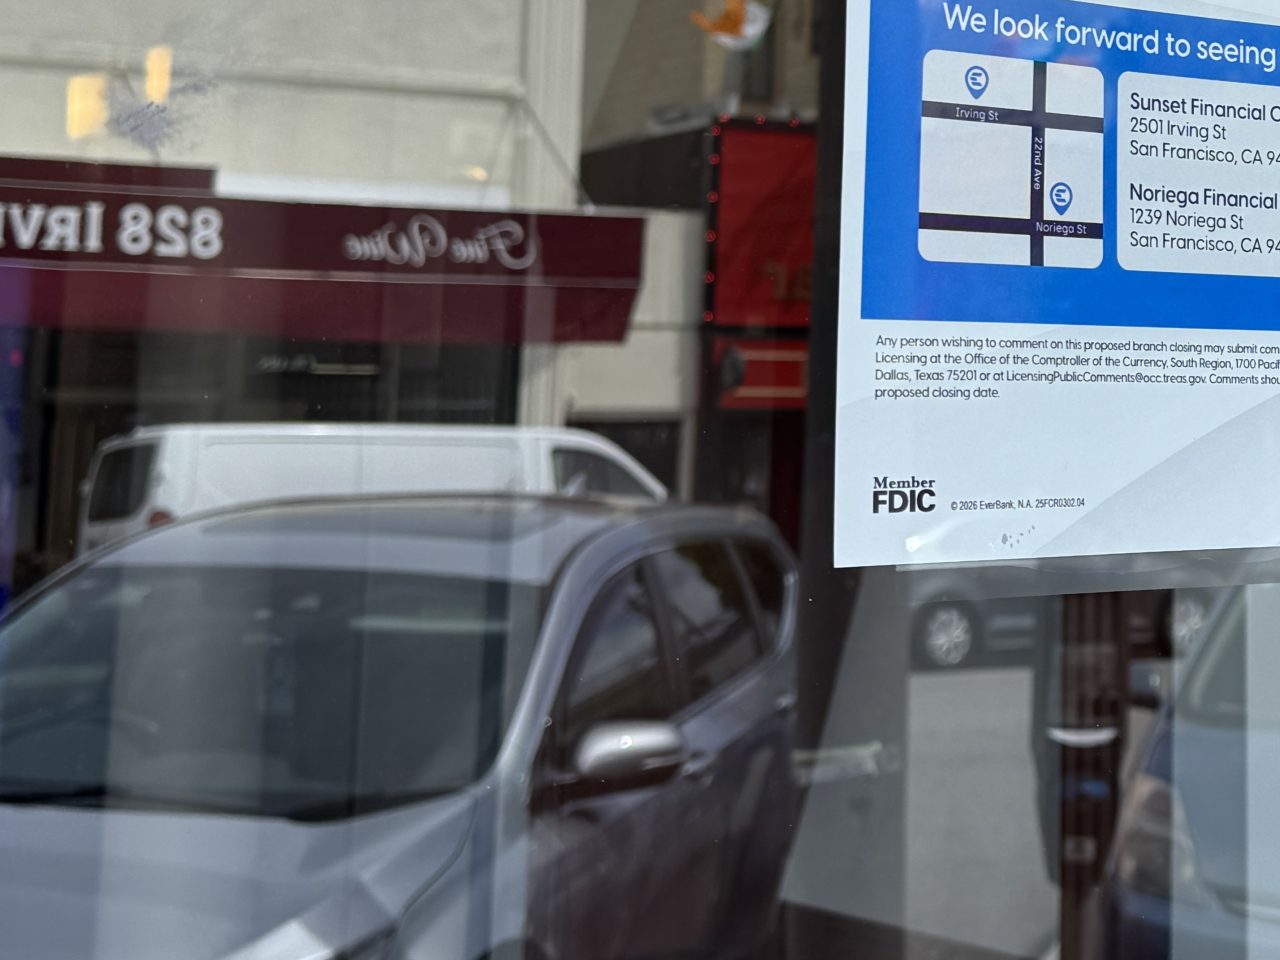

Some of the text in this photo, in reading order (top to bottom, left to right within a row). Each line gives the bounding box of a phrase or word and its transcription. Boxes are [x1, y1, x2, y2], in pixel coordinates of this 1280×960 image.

[944, 2, 986, 32] We
[994, 9, 1048, 40] look
[1056, 17, 1158, 54] forward
[1166, 33, 1190, 57] to
[1197, 40, 1275, 72] seeing
[955, 108, 999, 122] Irving St
[1131, 93, 1186, 114] Sunset
[1192, 98, 1265, 120] Financial
[1131, 117, 1226, 142] 2501 Irving St
[1034, 137, 1043, 190] 22nd Ave
[1130, 140, 1158, 156] San
[1163, 143, 1237, 165] Francisco,
[1242, 149, 1262, 164] CA
[1130, 184, 1198, 208] Noriega
[1204, 189, 1277, 209] Financial
[1036, 222, 1087, 235] Noriega St
[1130, 208, 1243, 232] 1239 Noriega St
[1130, 231, 1158, 247] San
[1163, 233, 1236, 254] Francisco,
[1241, 238, 1262, 253] CA
[876, 336, 897, 347] Any
[901, 338, 938, 348] person
[942, 337, 983, 350] wishing
[986, 338, 996, 347] to
[999, 340, 1048, 348] comment
[1051, 341, 1063, 349] on
[1066, 340, 1082, 349] this
[1084, 341, 1130, 352] proposed
[1133, 341, 1167, 351] branch
[1170, 342, 1202, 354] closing
[1204, 345, 1224, 355] may
[1228, 344, 1257, 353] submit
[876, 352, 927, 366] Licensing
[930, 354, 940, 363] at
[944, 354, 961, 364] the
[965, 354, 996, 364] Office
[1000, 354, 1010, 364] of
[1013, 355, 1029, 364] the
[1032, 355, 1090, 366] Comptroller
[1093, 356, 1102, 366] of
[1105, 357, 1120, 366] the
[1171, 358, 1197, 367] South
[1200, 358, 1233, 370] Region,
[1236, 359, 1256, 368] 1700
[876, 369, 911, 381] Dallas,
[914, 370, 944, 380] Texas
[947, 370, 976, 380] 75201
[993, 372, 1003, 381] at
[1210, 374, 1258, 384] Comments
[875, 387, 1000, 400] proposed closing date.
[874, 476, 935, 488] Member
[873, 489, 935, 513] FDIC
[959, 500, 978, 510] 2026
[1018, 499, 1033, 509] N.A.
